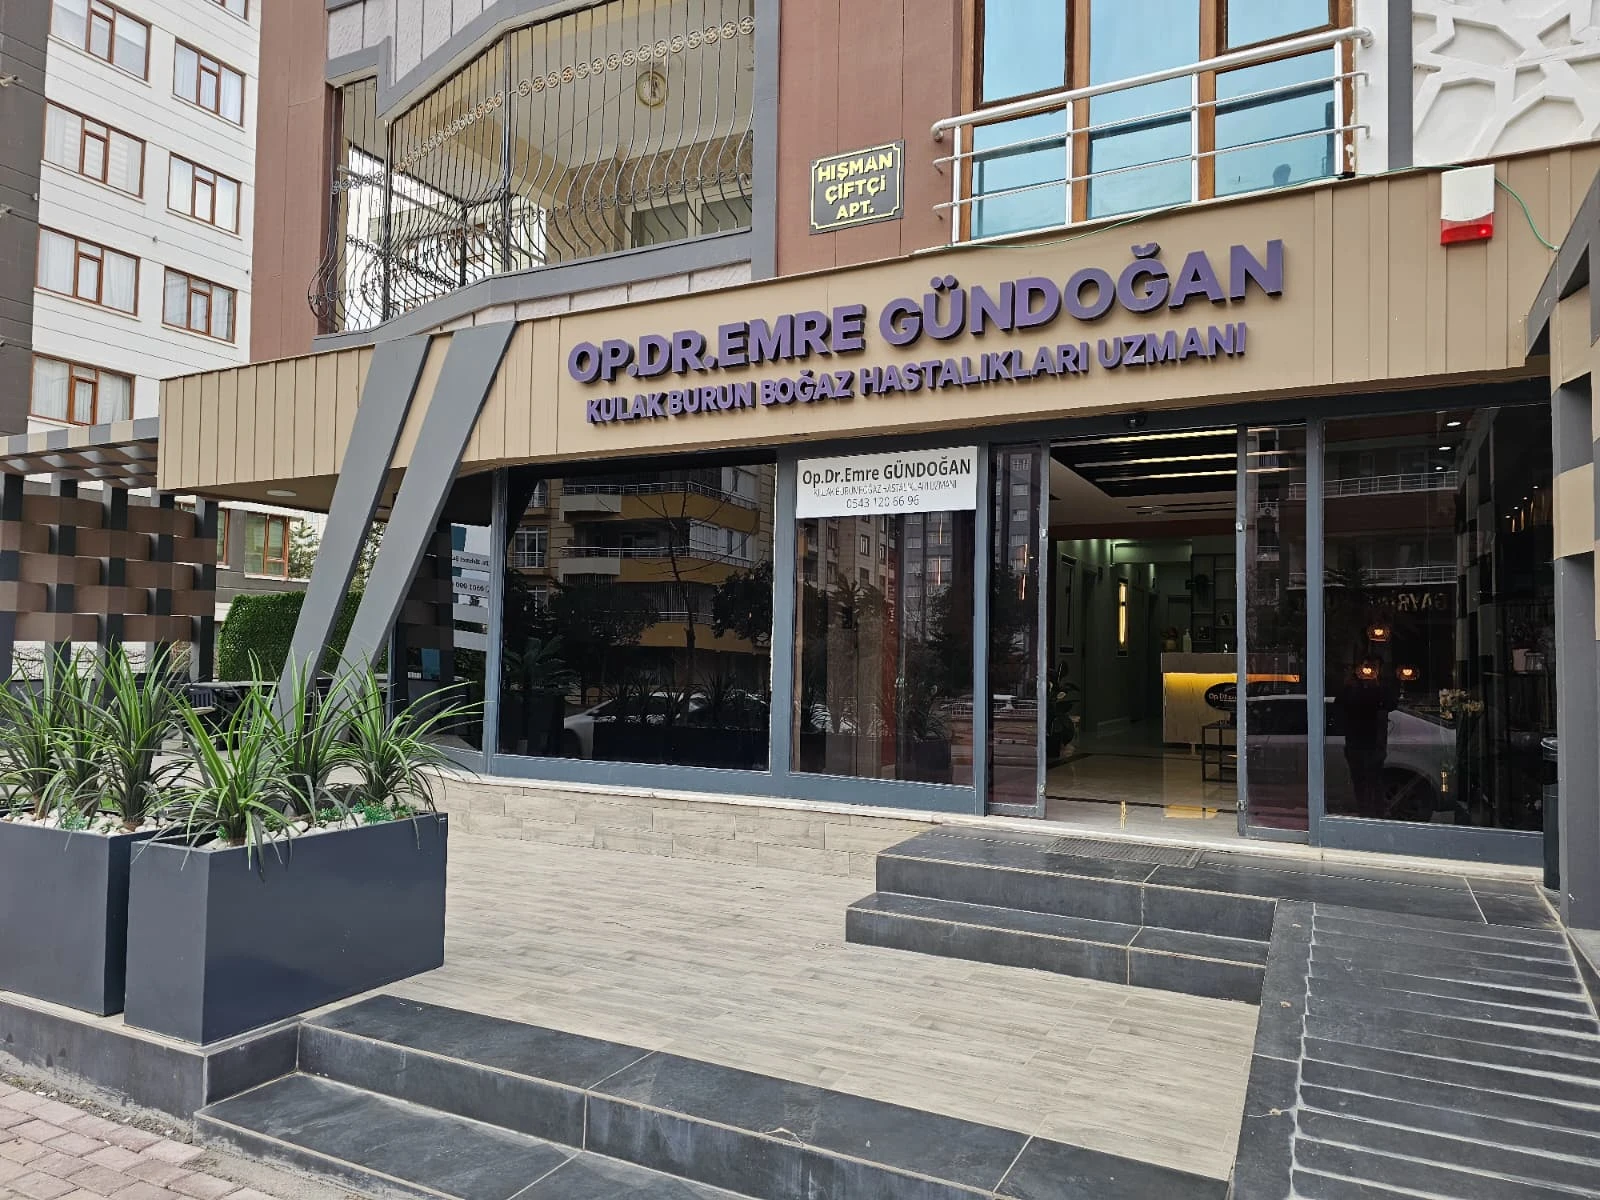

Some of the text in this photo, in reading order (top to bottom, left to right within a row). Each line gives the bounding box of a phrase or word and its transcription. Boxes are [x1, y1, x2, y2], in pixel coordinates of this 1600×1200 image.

[817, 152, 894, 183] HIŞMAN
[835, 199, 875, 220] APT.
[568, 239, 1284, 385] OP.DR.EMRE GÜNDOĞAN
[586, 322, 1248, 424] KULAK BURUN BOĞAZ HASTALIKLARI UZMANI
[802, 456, 971, 489] Op.Dr.Emre GÜNDOĞAN
[846, 497, 870, 509] 0543
